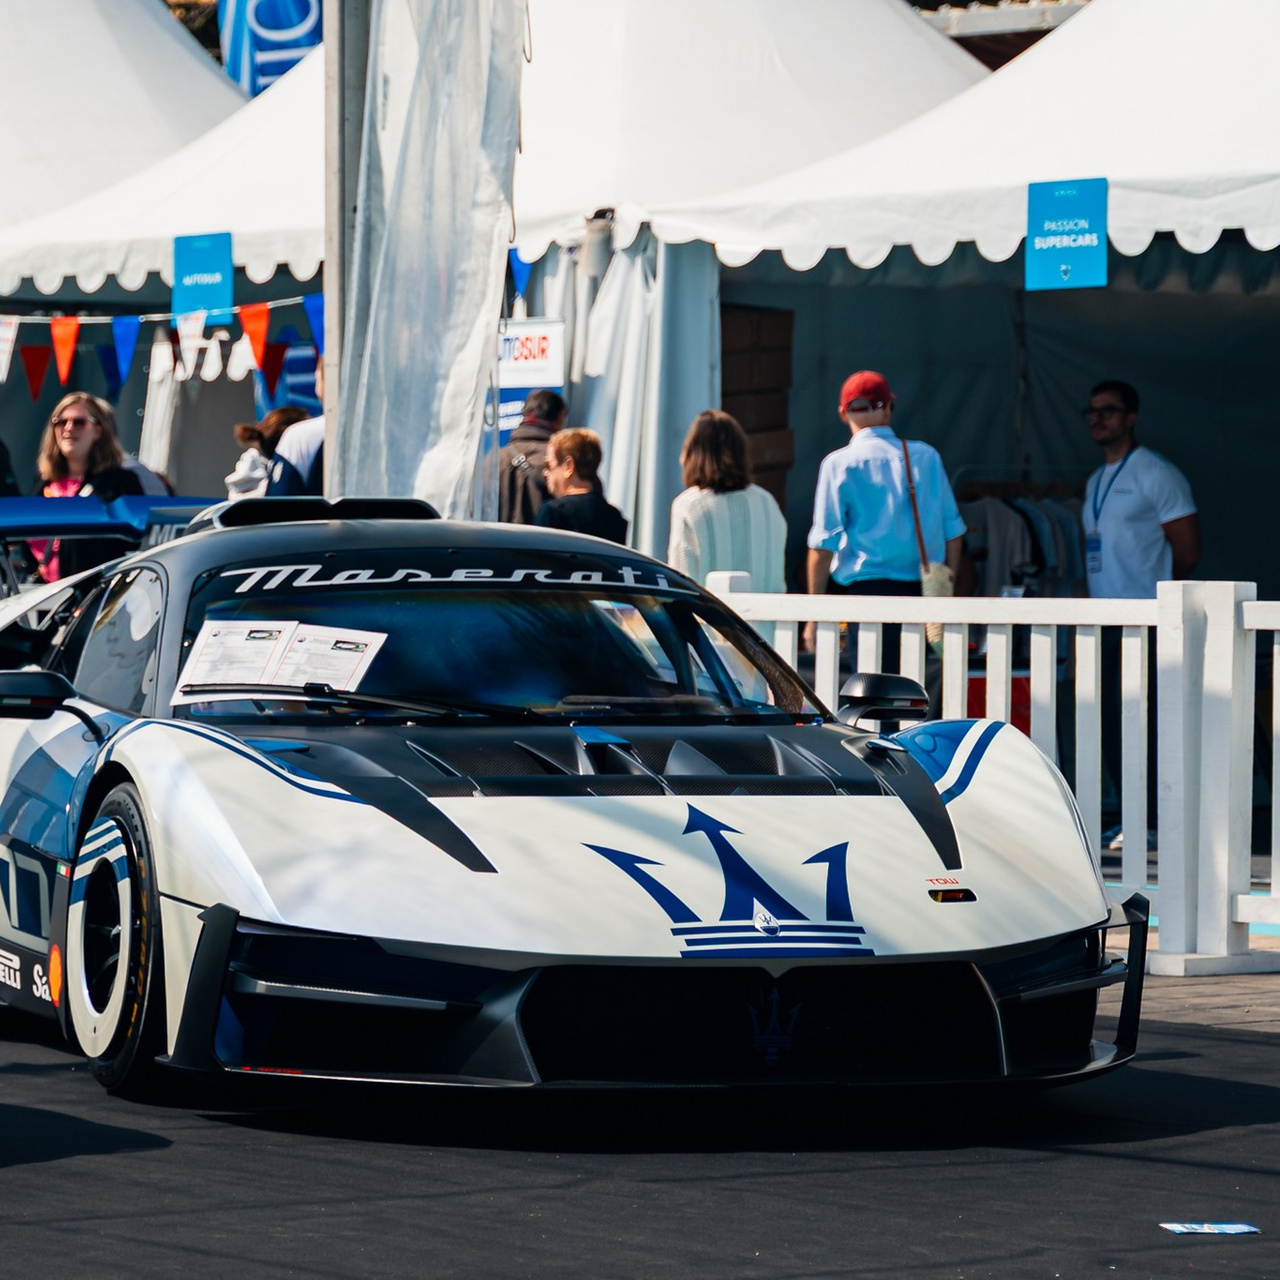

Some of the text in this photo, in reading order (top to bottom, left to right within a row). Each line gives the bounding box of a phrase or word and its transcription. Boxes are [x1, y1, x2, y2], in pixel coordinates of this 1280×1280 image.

[1044, 219, 1089, 231] PASSION
[1034, 233, 1098, 250] SUPERCARS
[497, 336, 549, 361] UTOSUR
[221, 565, 700, 595] Maserati
[925, 878, 960, 886] TOW
